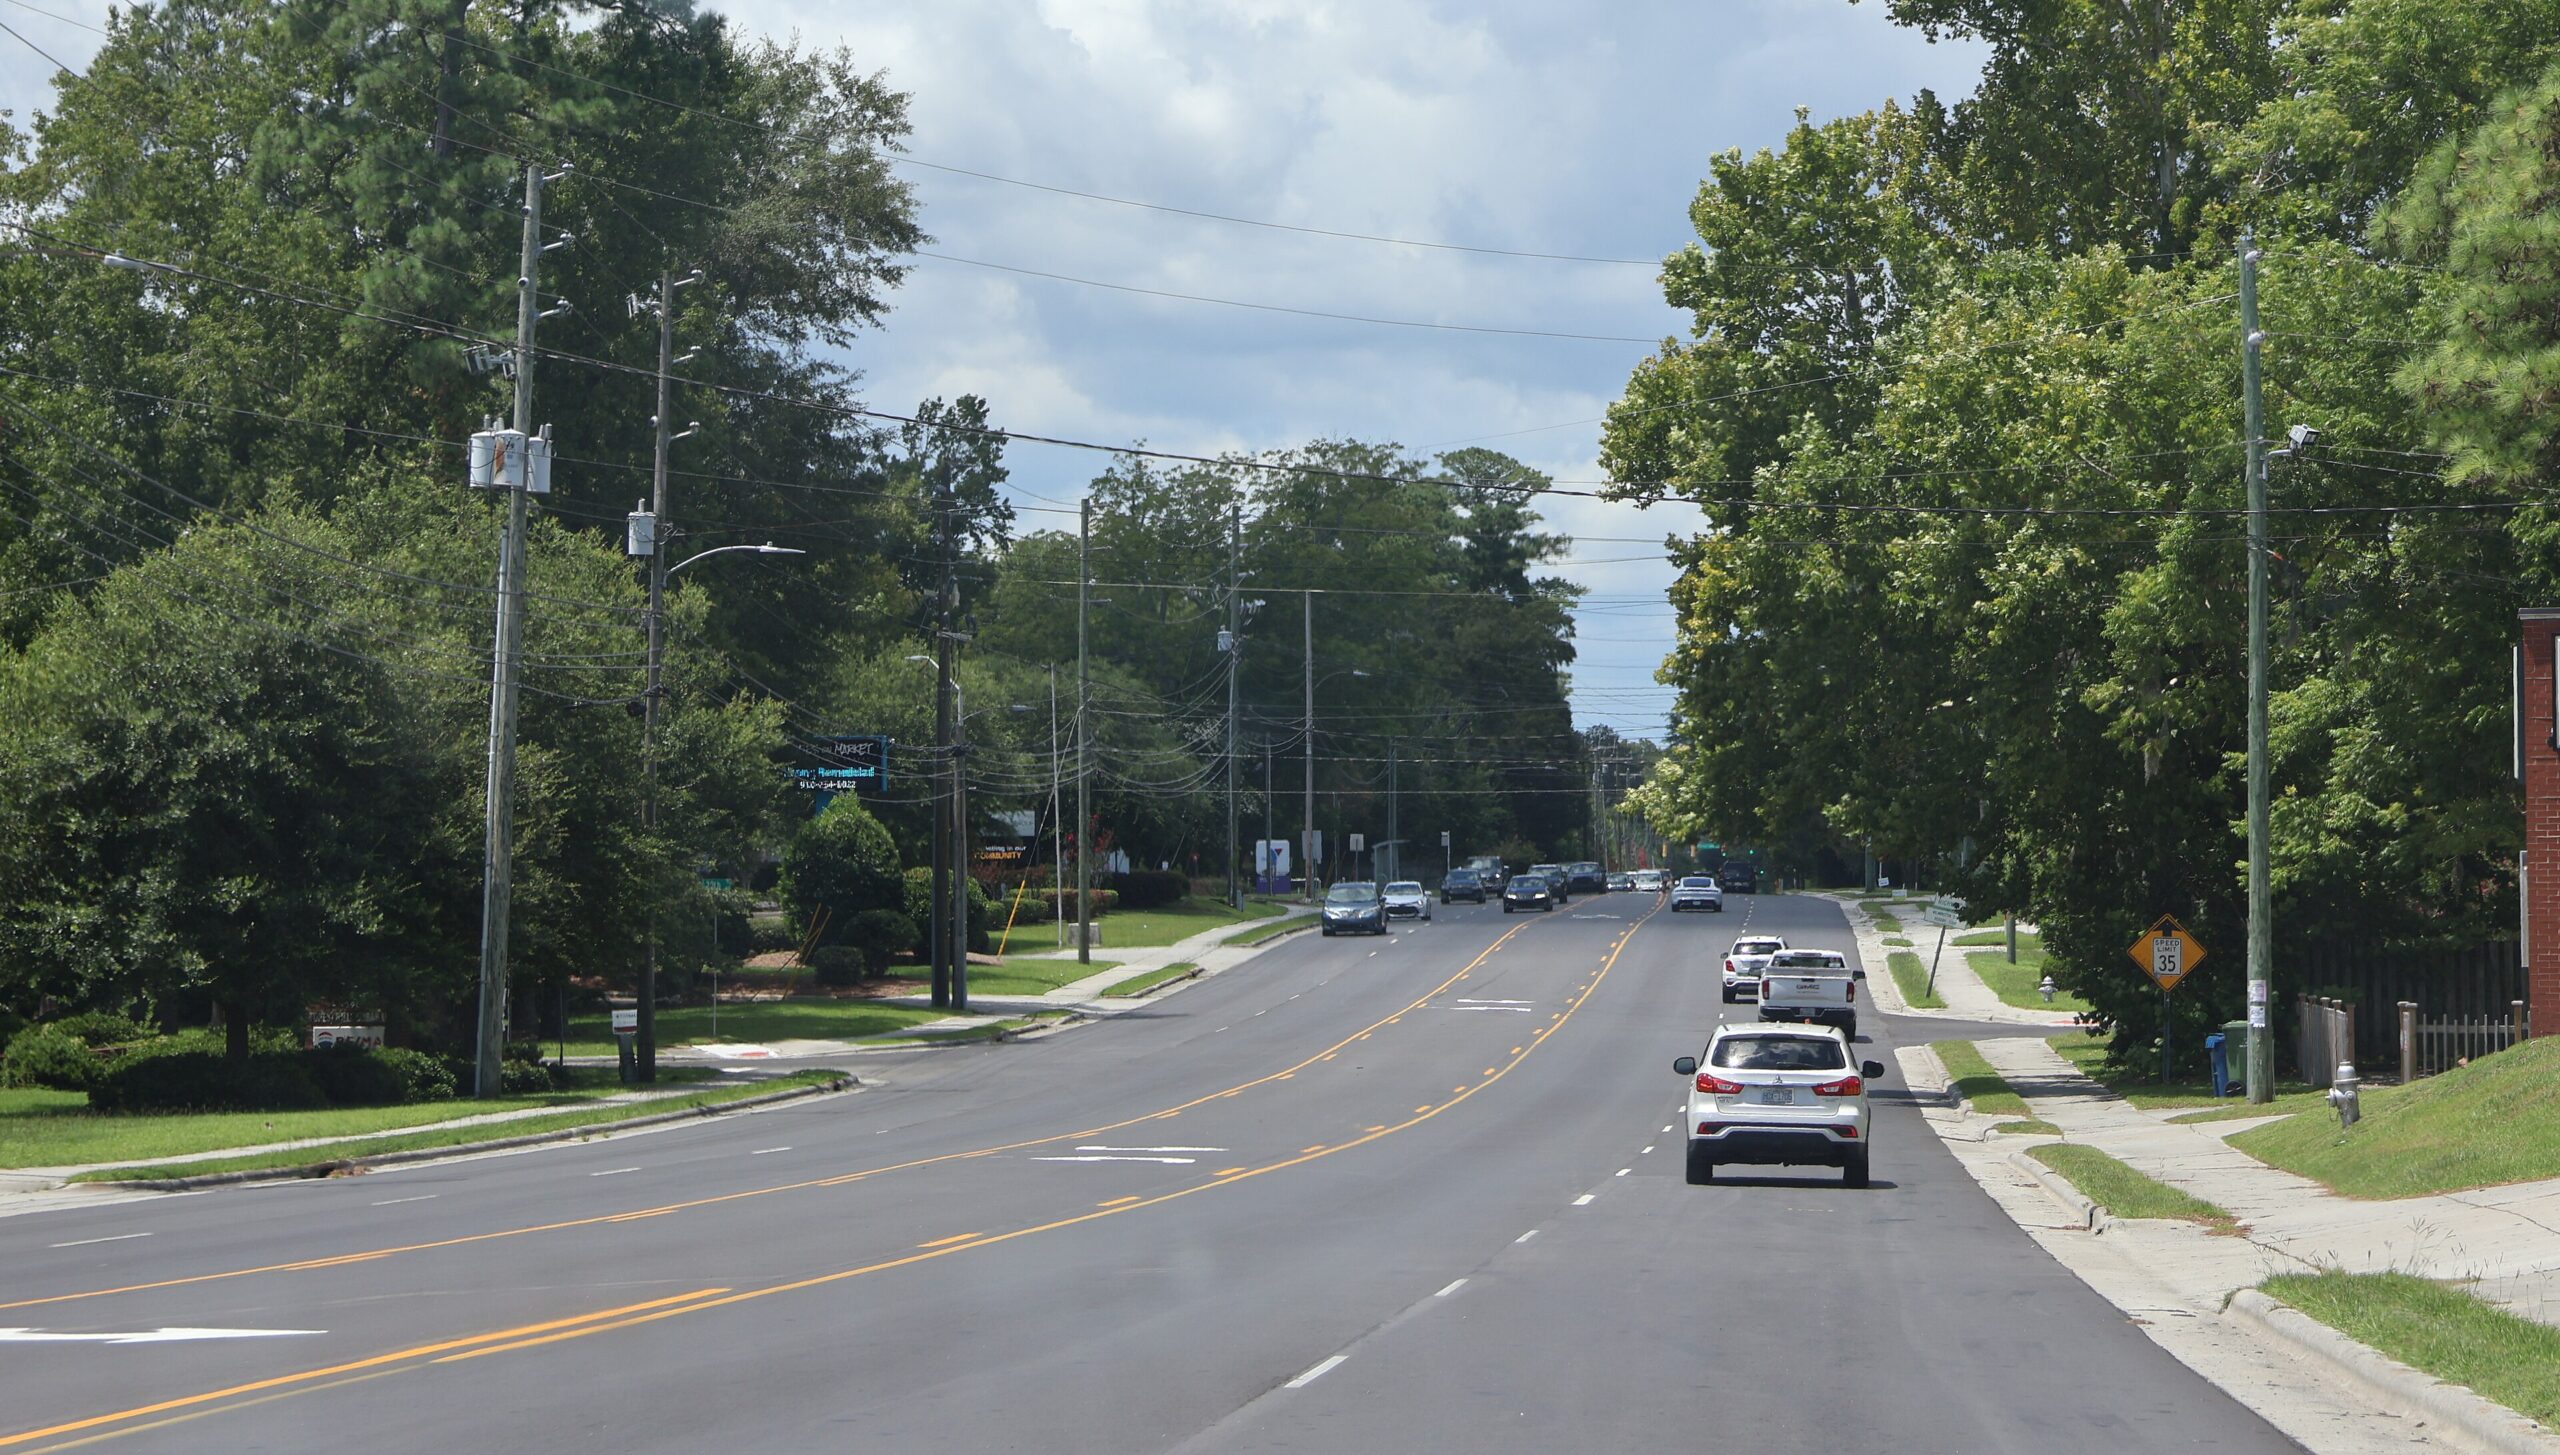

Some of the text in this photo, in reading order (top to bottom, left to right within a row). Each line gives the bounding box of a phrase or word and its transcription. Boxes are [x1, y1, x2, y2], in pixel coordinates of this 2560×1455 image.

[835, 743, 874, 755] MARKET
[2159, 955, 2176, 972] 35
[336, 1036, 384, 1049] RE/MA
